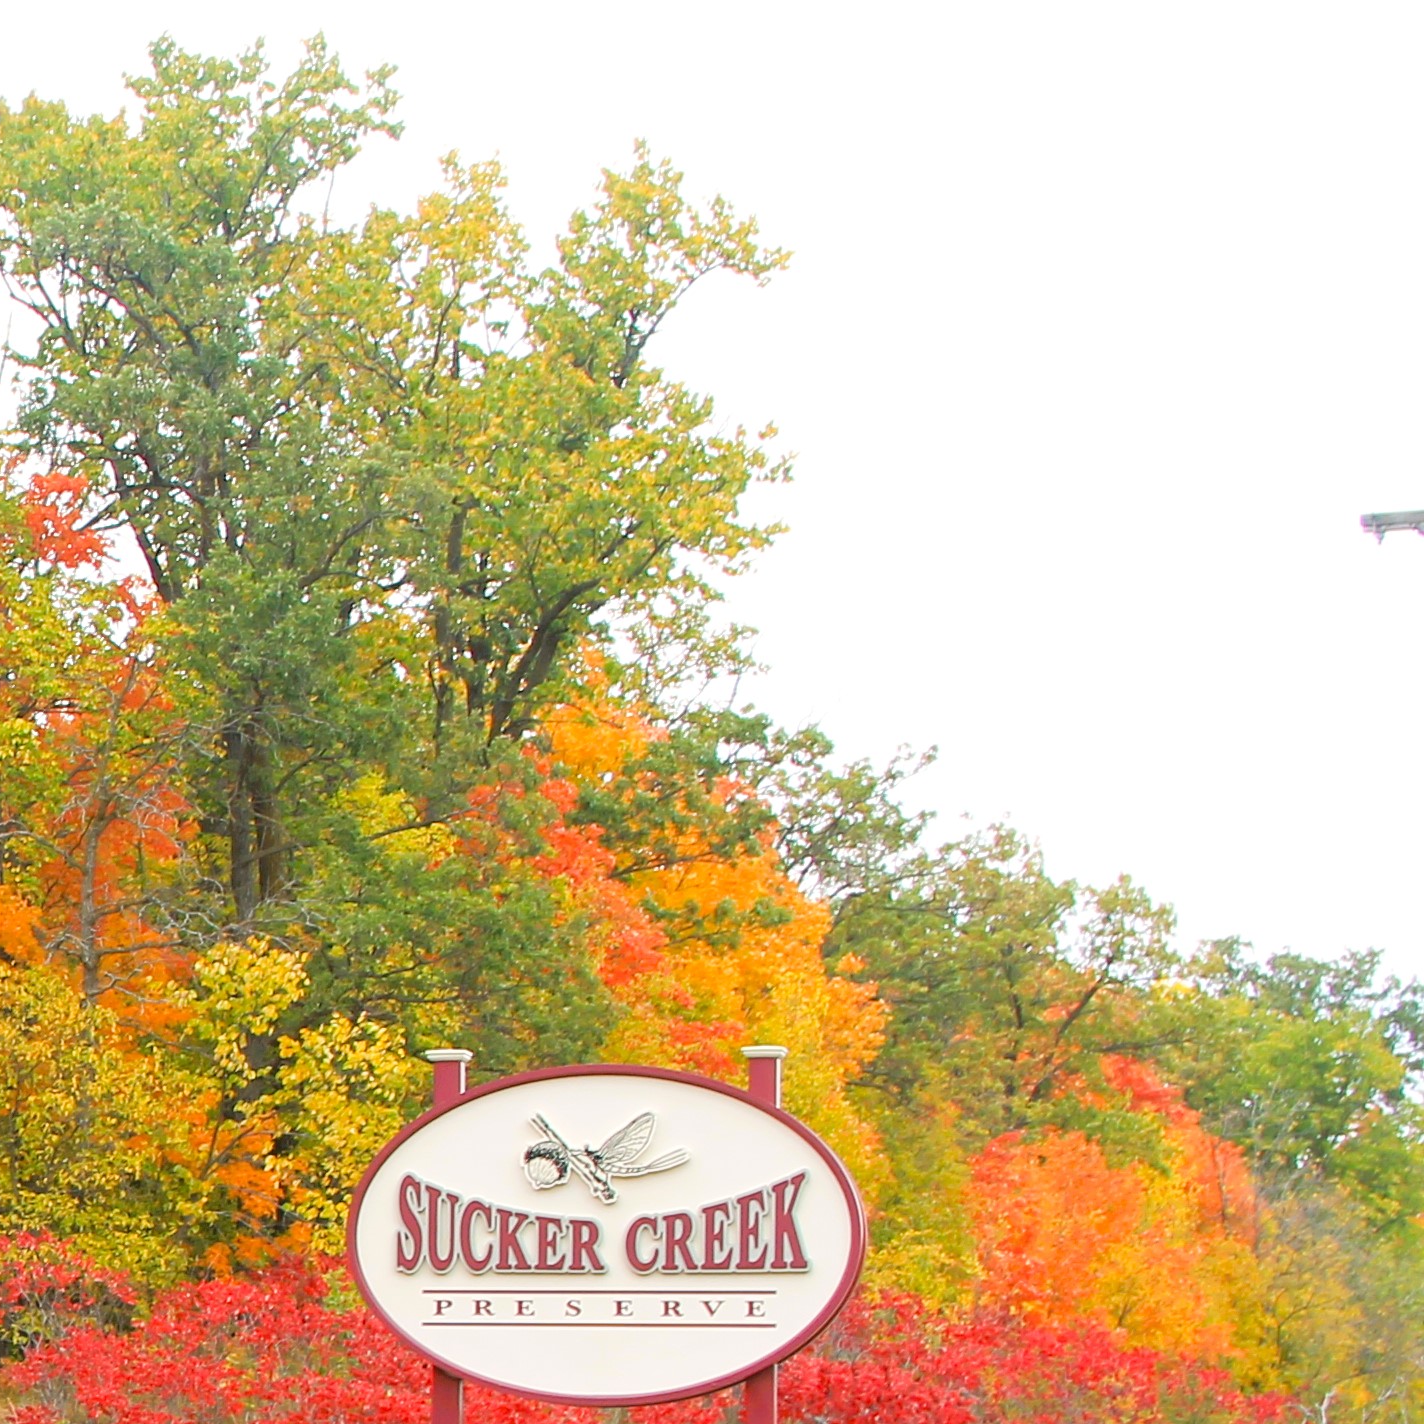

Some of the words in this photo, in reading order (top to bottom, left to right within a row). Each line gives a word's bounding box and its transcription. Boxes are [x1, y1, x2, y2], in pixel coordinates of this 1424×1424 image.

[397, 1174, 605, 1272] SUCKER
[625, 1171, 809, 1272] CREEK
[433, 1299, 767, 1317] PRESERVE
